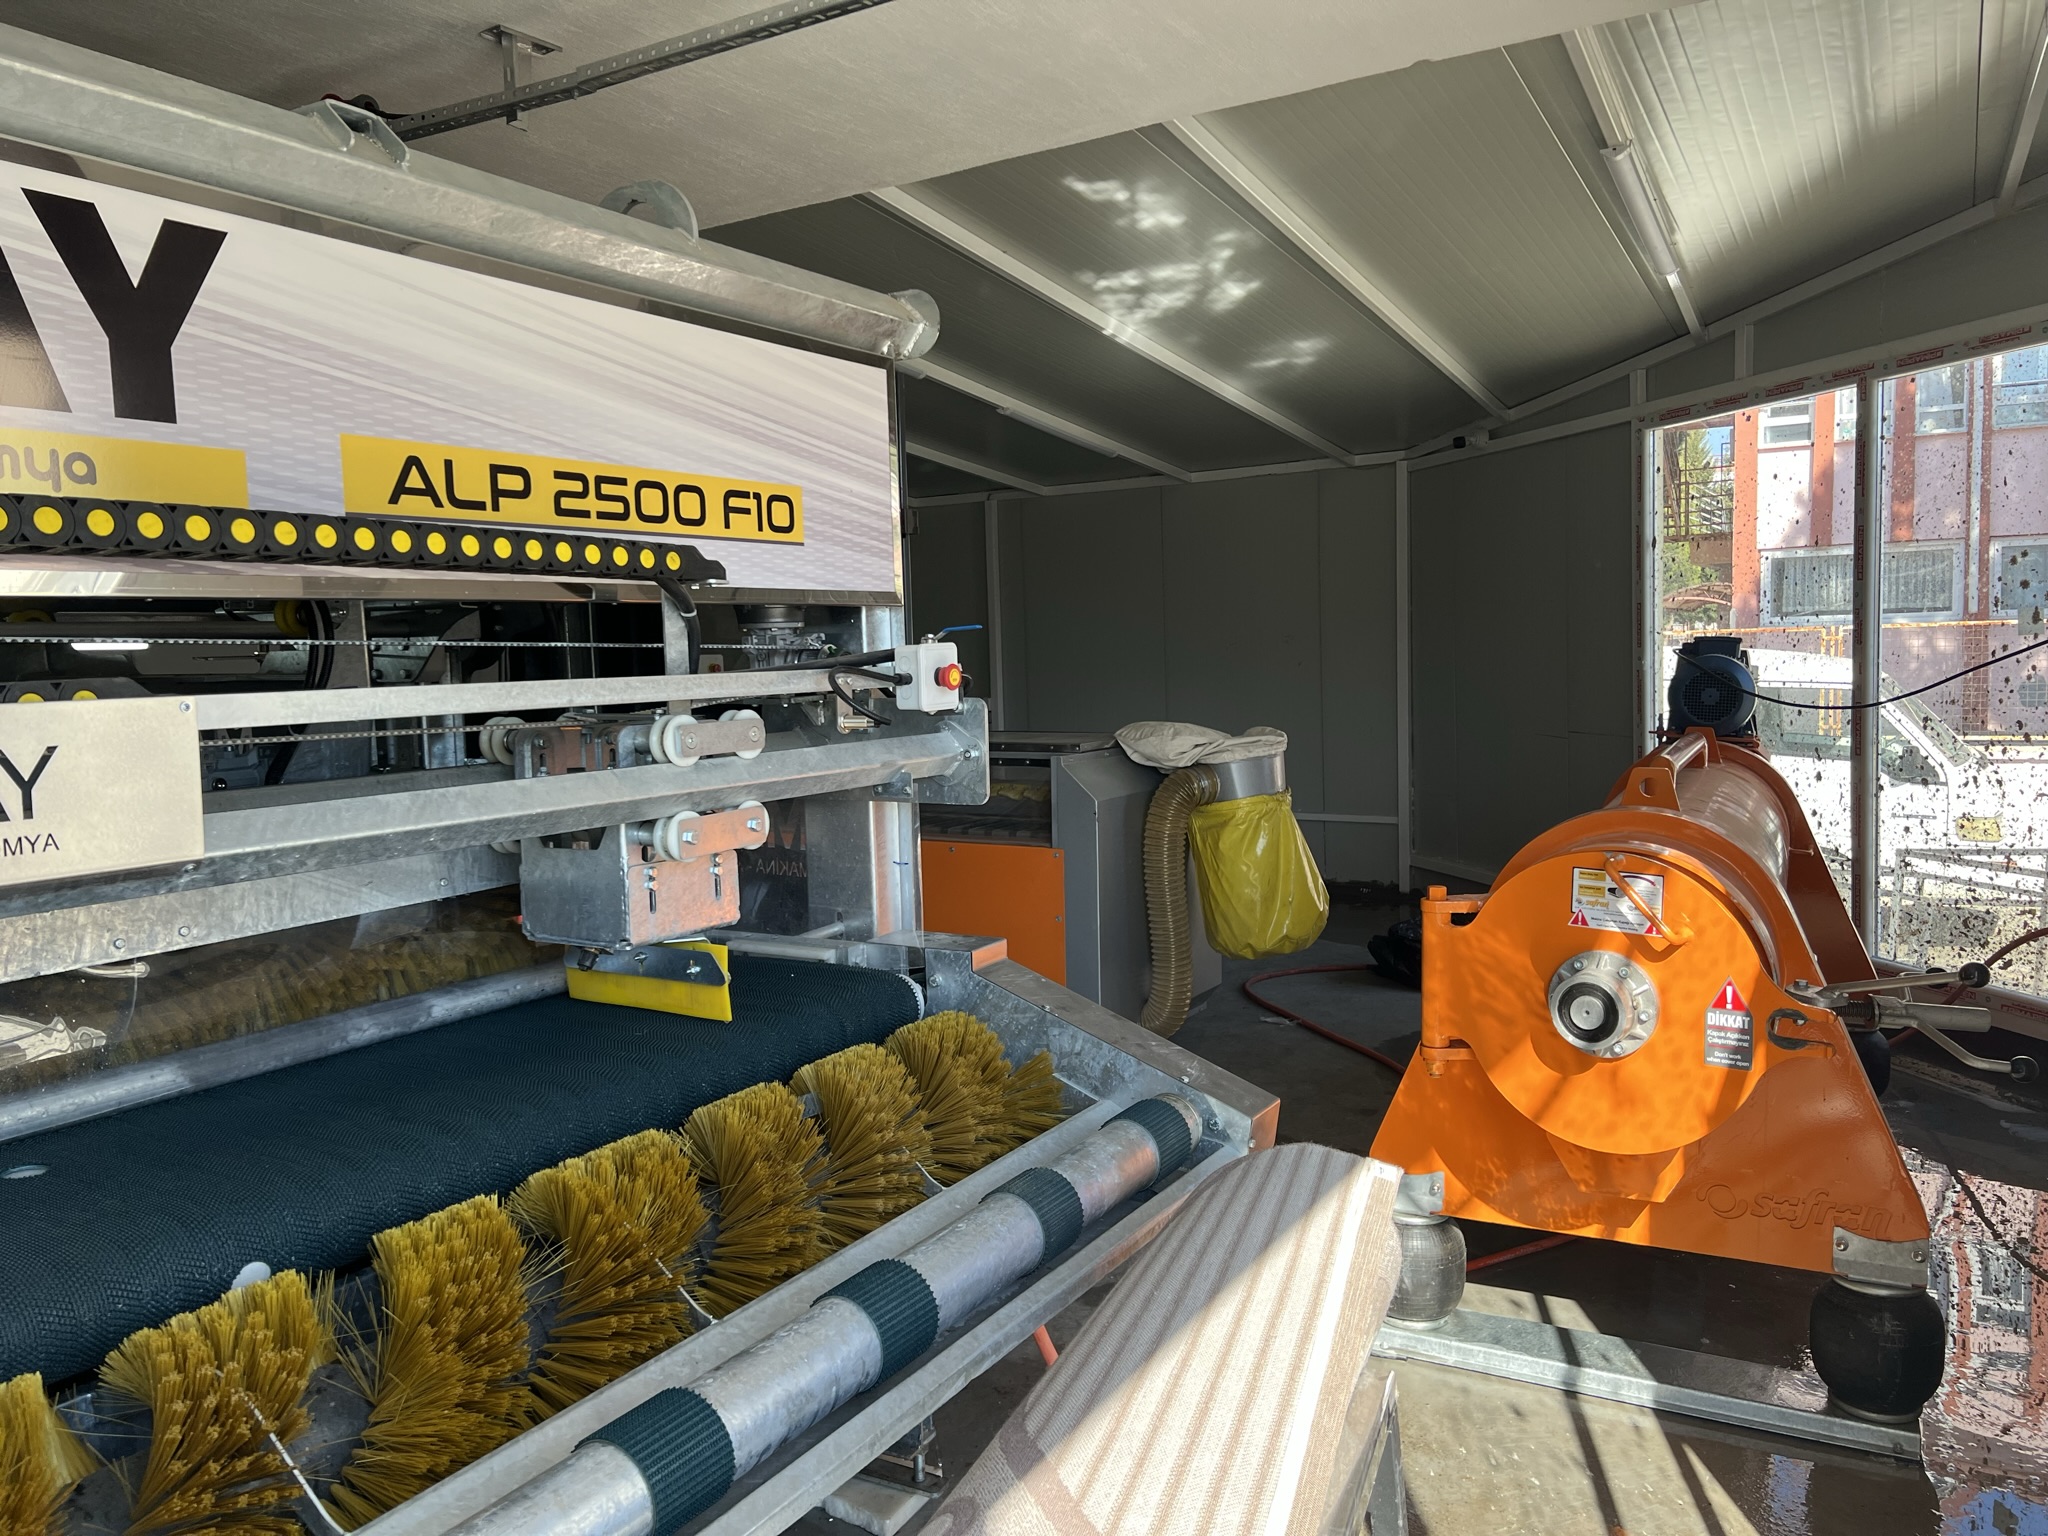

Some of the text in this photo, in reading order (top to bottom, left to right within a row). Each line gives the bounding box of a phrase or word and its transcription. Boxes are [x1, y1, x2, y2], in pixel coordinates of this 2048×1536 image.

[388, 455, 795, 534] ALP 2500 F10
[0, 745, 58, 822] Y
[1707, 1011, 1750, 1029] DİKKAT
